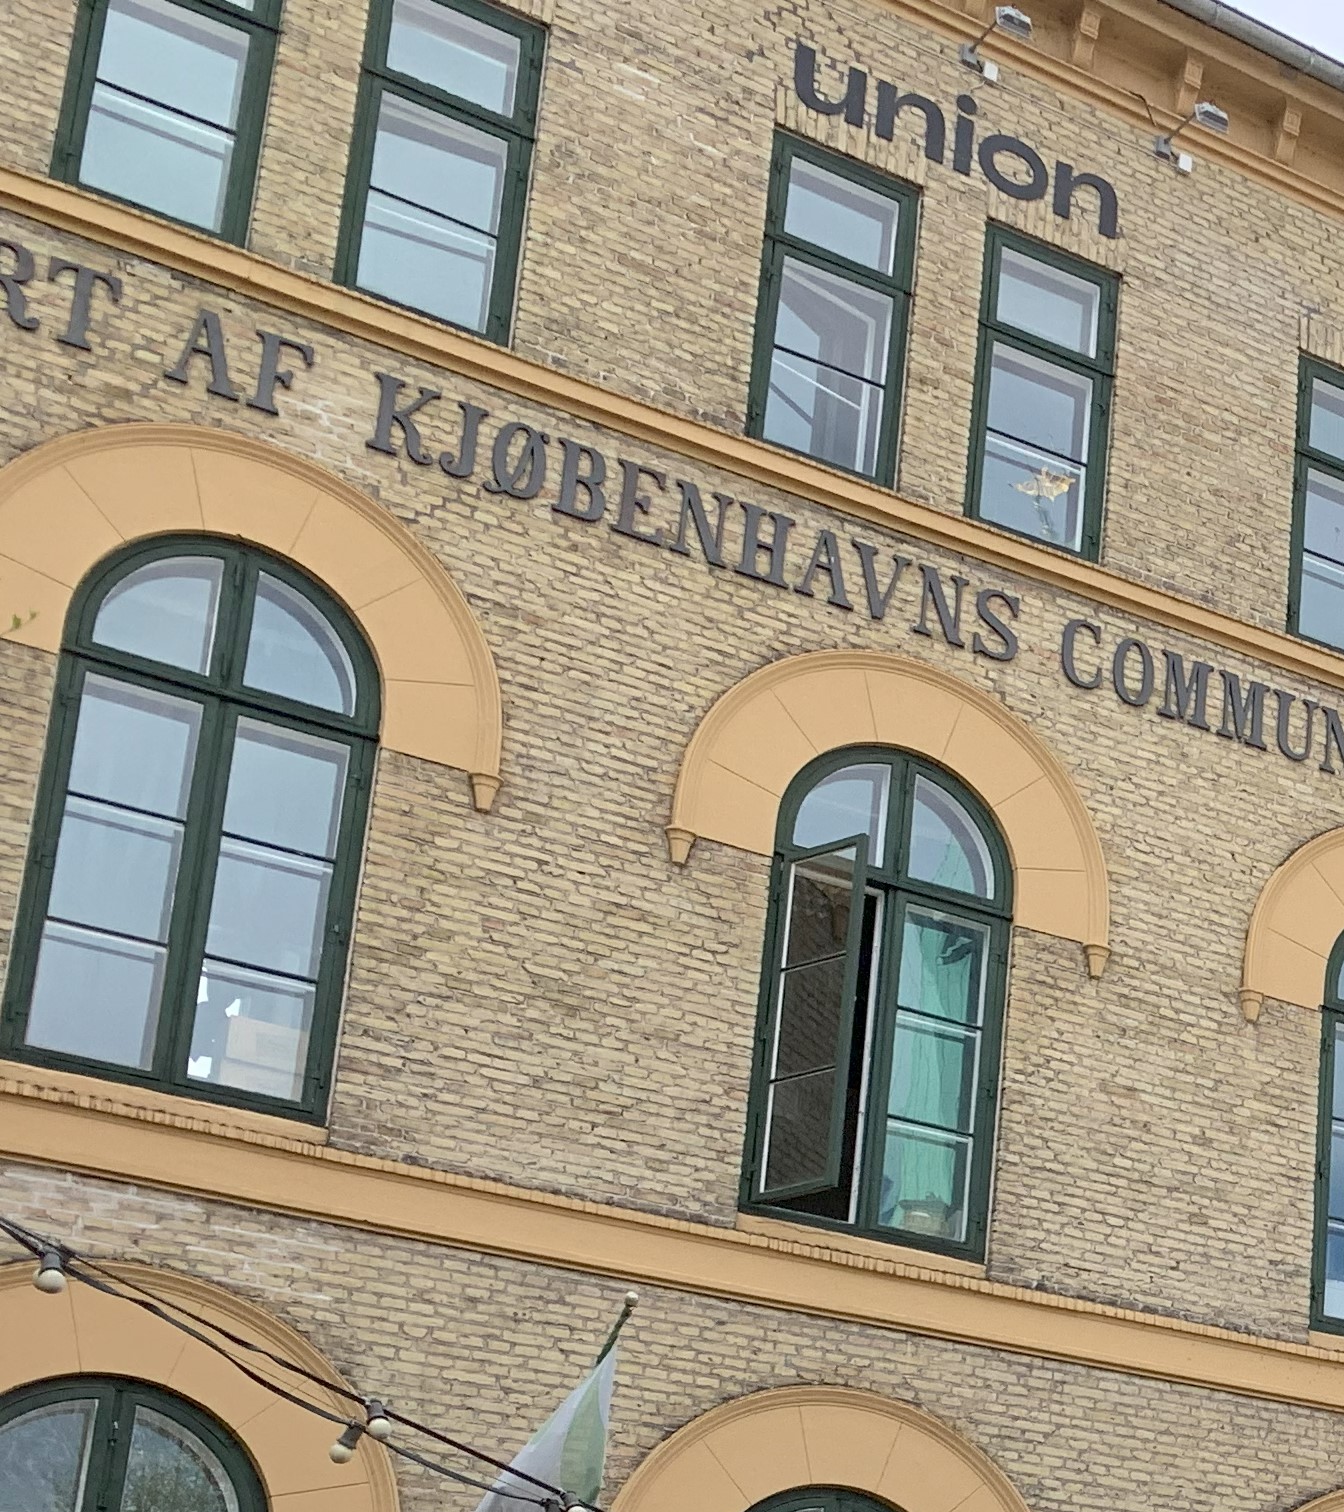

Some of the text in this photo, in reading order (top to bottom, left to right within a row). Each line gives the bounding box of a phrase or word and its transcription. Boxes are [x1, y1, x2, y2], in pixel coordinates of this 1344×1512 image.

[795, 42, 1120, 238] union
[164, 308, 315, 416] AF
[366, 370, 1022, 662] KJØBENHAVNS
